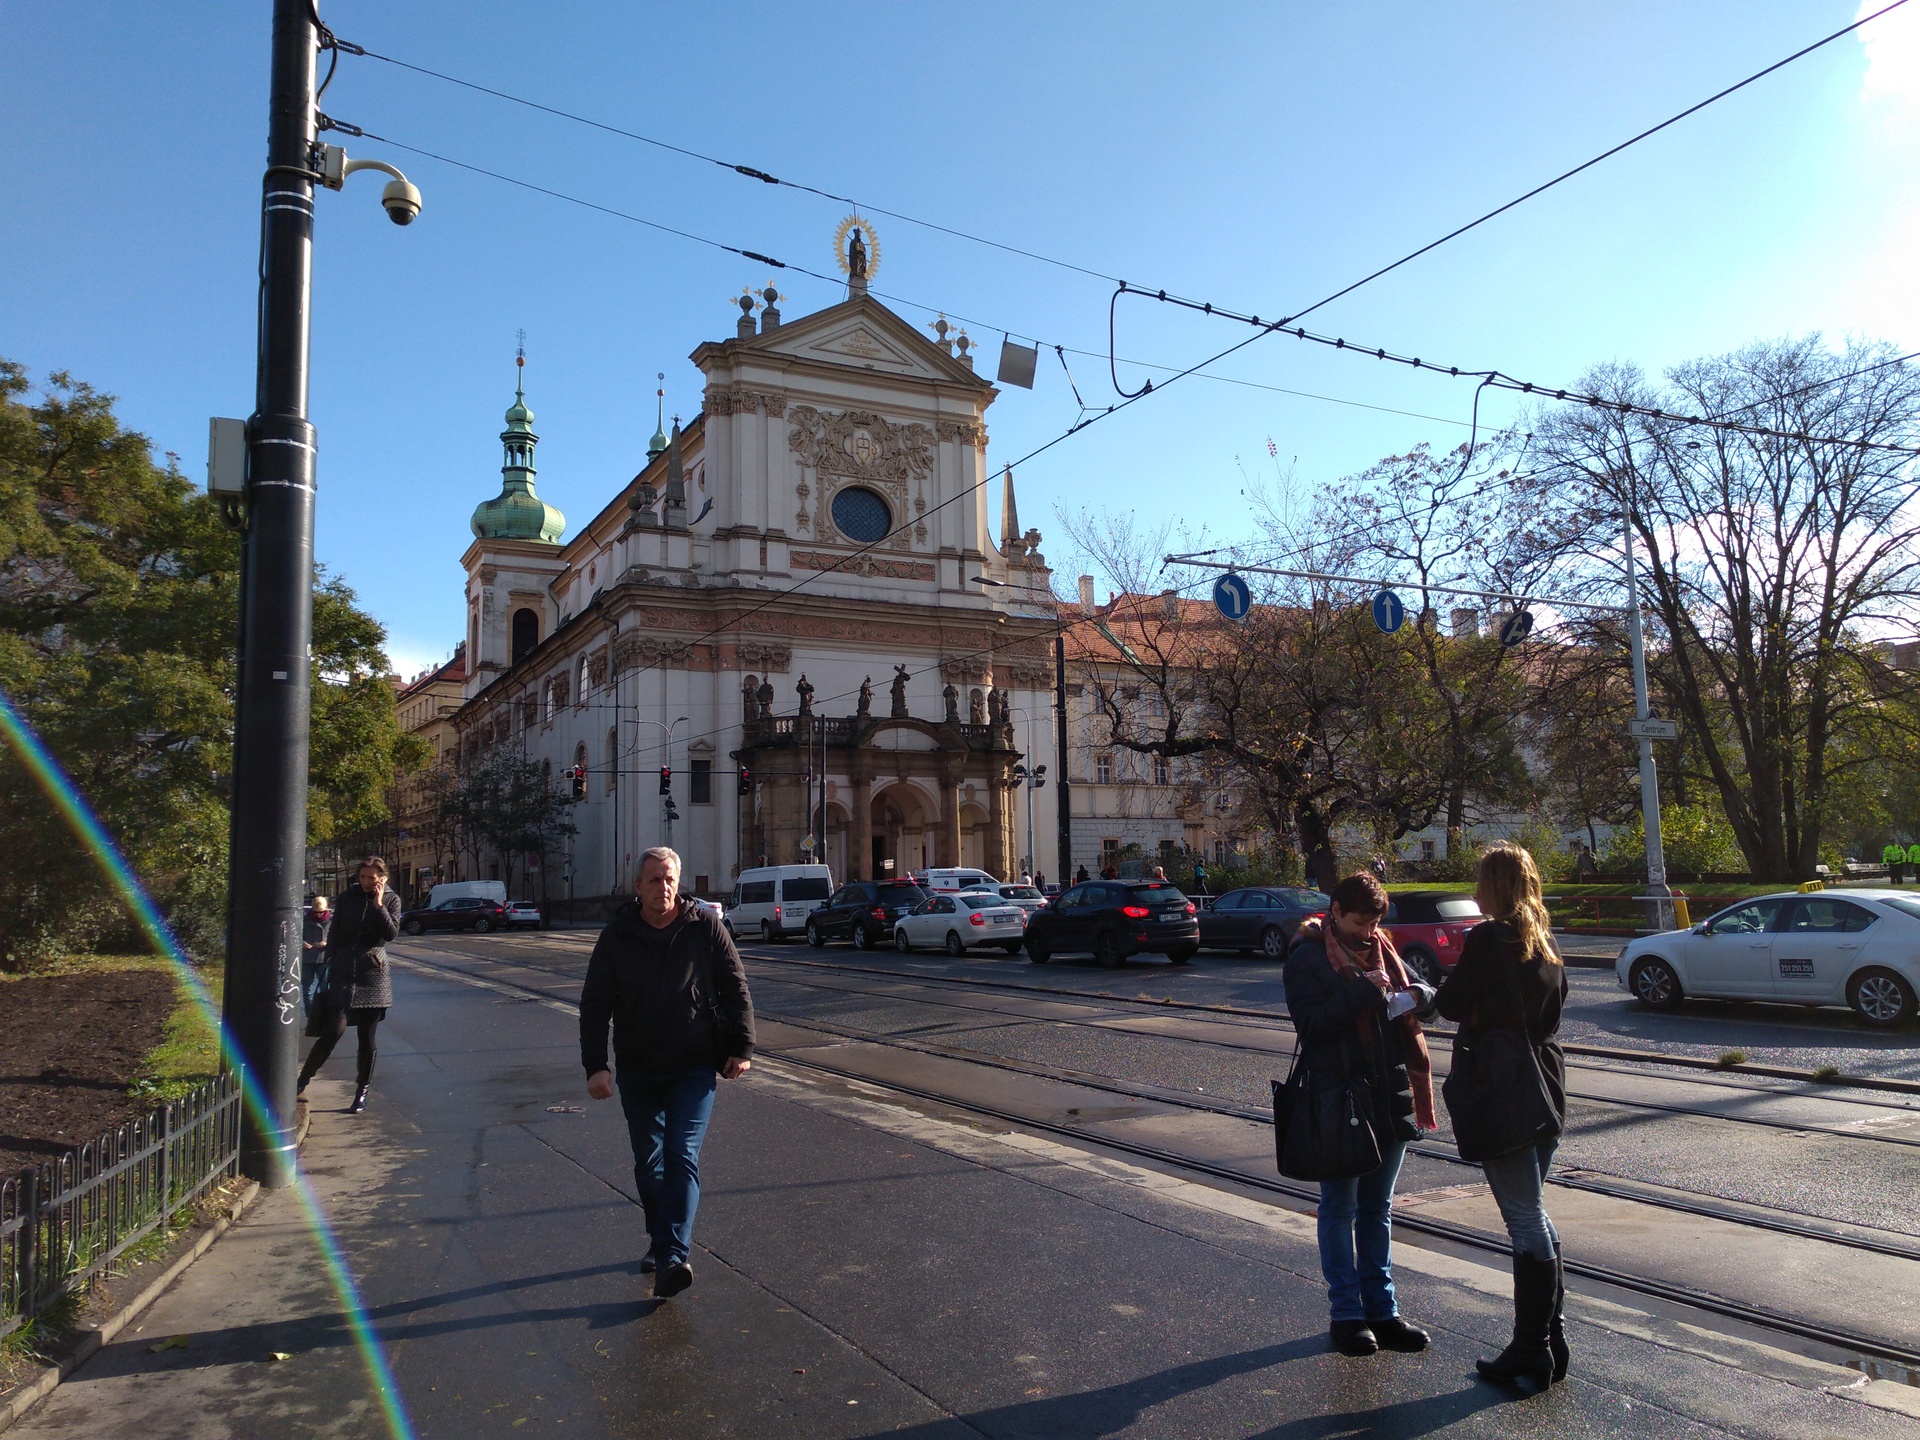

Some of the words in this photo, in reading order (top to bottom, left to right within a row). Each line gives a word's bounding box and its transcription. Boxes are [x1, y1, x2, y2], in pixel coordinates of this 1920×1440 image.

[1641, 724, 1667, 735] Centrum
[1807, 882, 1822, 892] TAXI
[1780, 964, 1791, 972] 251
[1791, 964, 1802, 972] 251
[1802, 964, 1813, 973] 251
